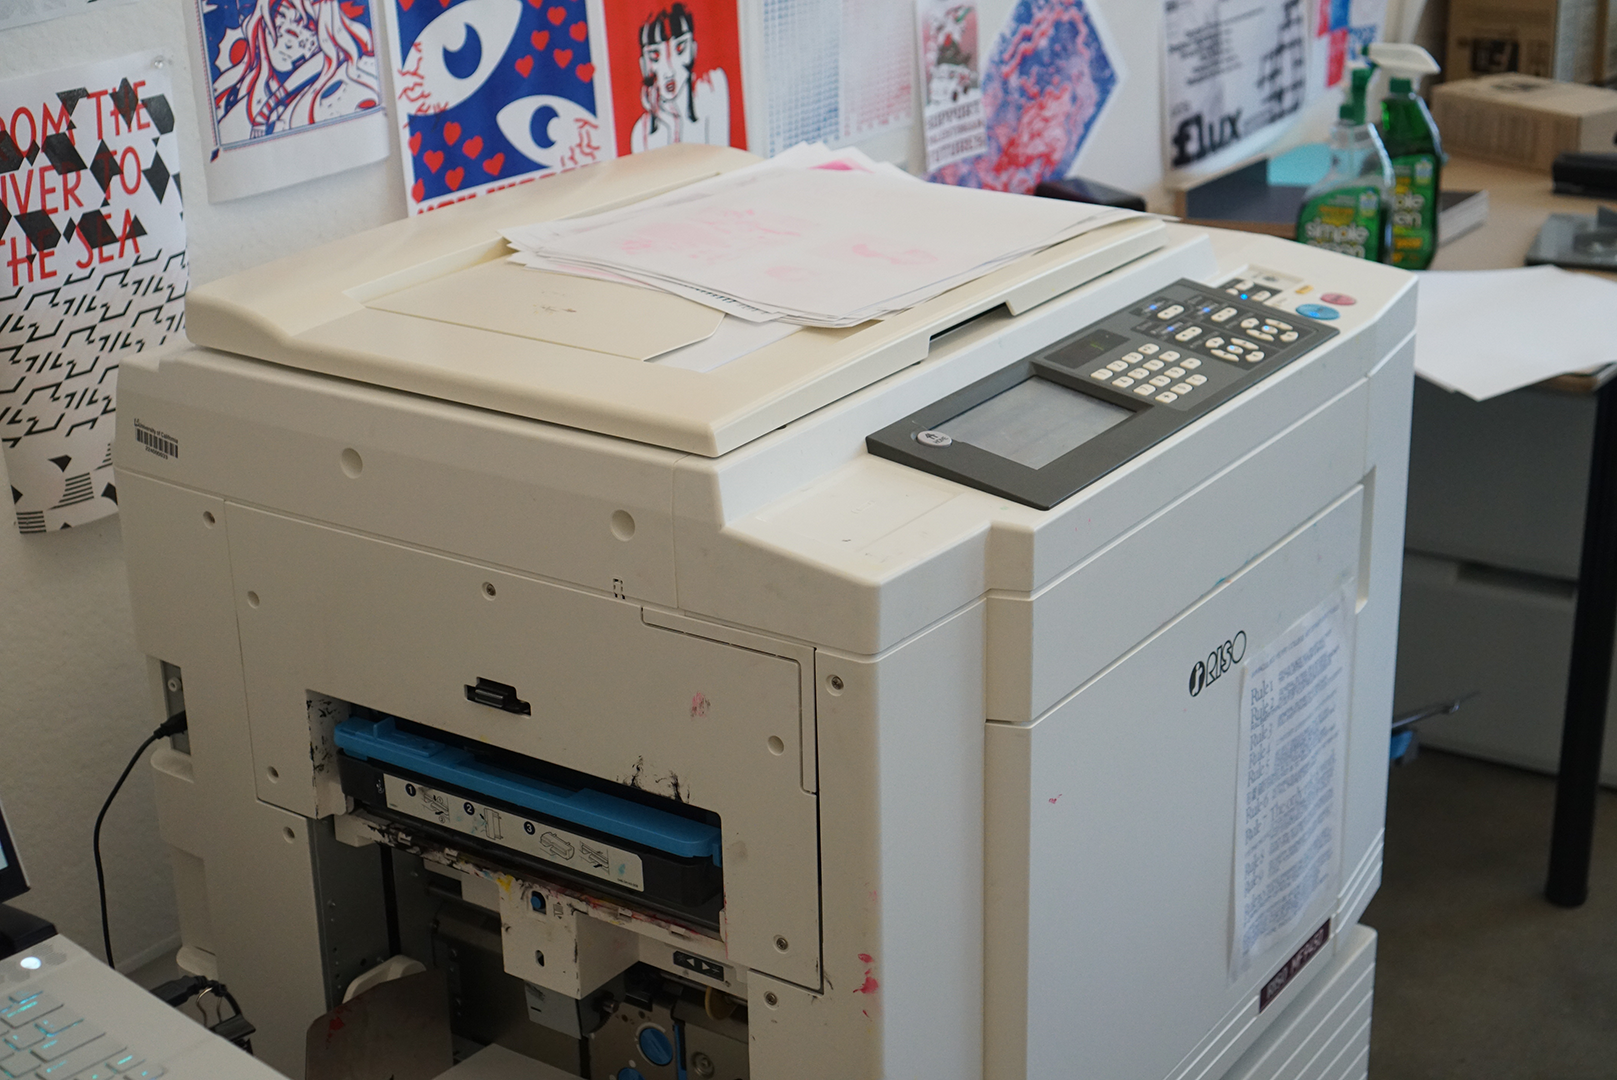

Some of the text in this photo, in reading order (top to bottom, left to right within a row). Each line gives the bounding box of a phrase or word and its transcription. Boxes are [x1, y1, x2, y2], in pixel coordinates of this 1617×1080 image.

[87, 80, 150, 140] THE
[95, 146, 141, 200] TO
[75, 208, 141, 269] SEA
[161, 432, 179, 444] California
[1205, 630, 1247, 688] RISO
[1251, 680, 1269, 706] Rule
